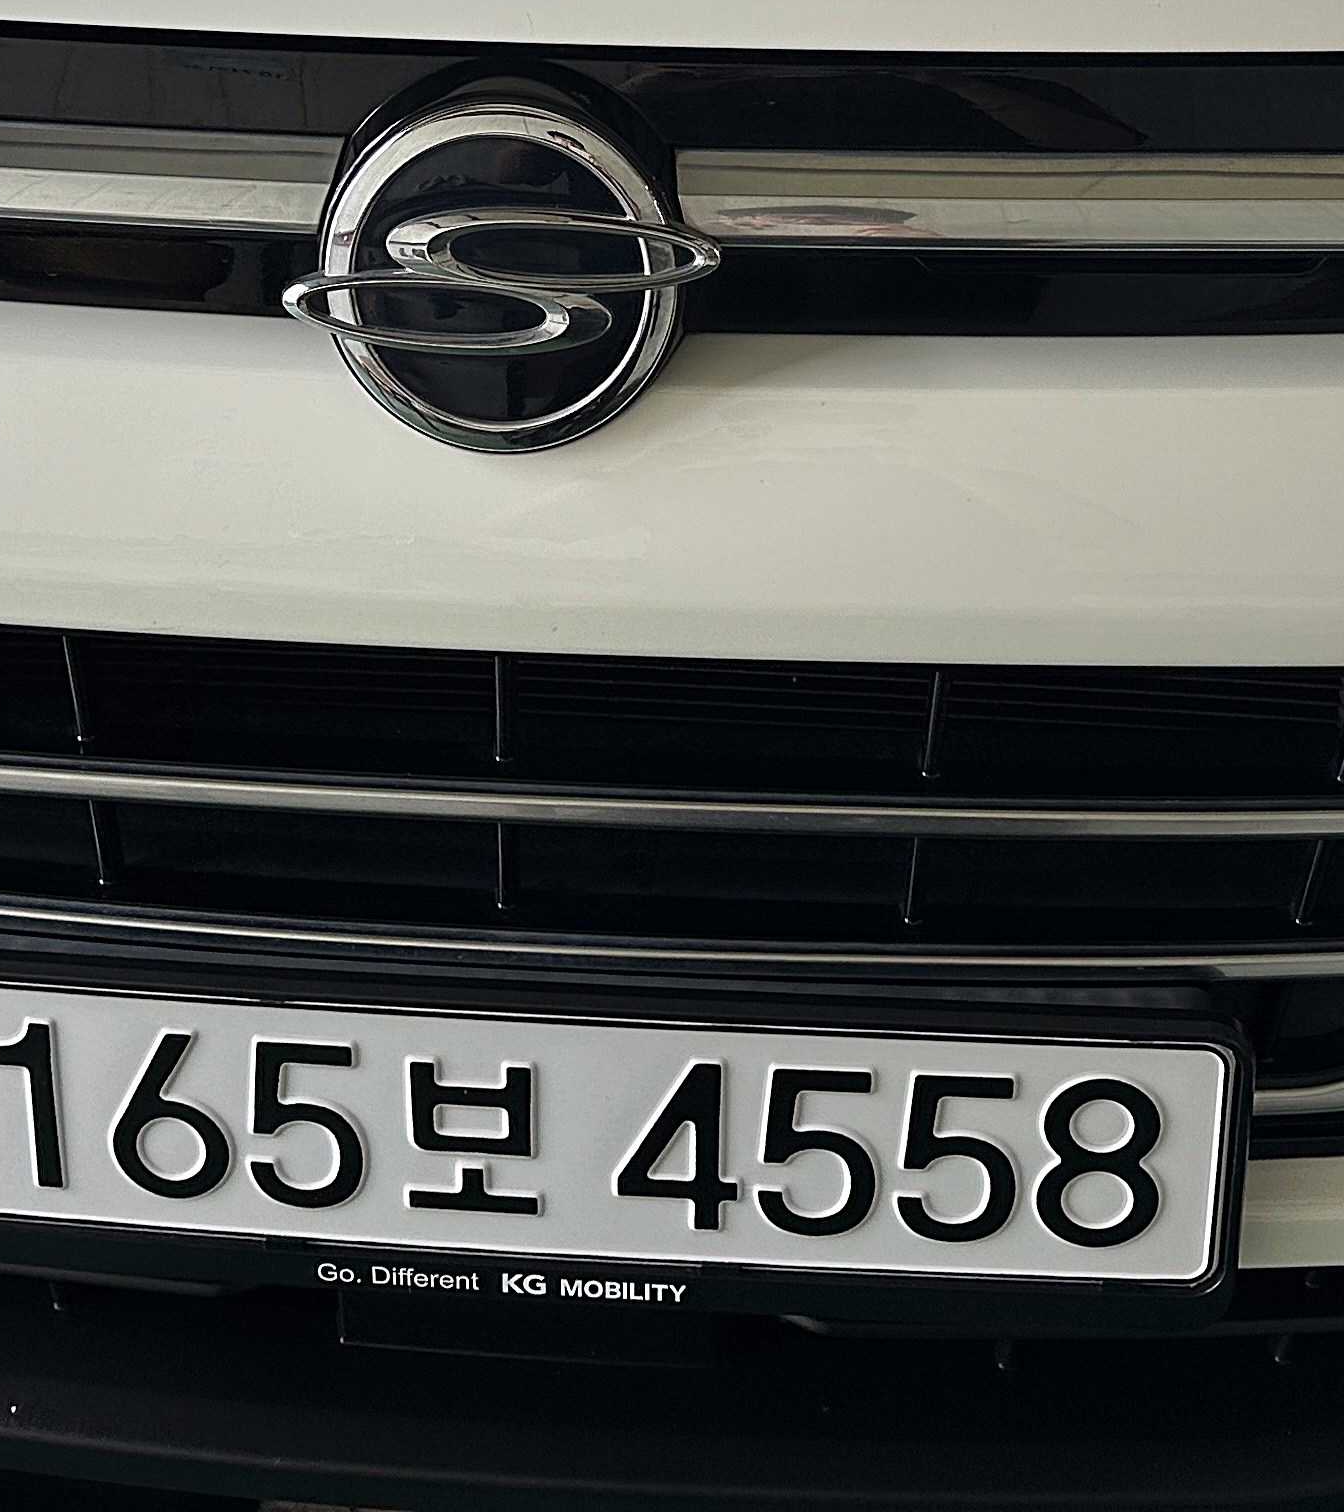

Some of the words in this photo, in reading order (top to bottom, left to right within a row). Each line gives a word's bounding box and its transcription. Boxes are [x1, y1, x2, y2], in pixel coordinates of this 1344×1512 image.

[613, 1058, 1164, 1249] 4558
[316, 1263, 362, 1284] Go.
[371, 1265, 480, 1291] Different
[501, 1272, 547, 1295] KG
[559, 1278, 687, 1303] MOBILITY
